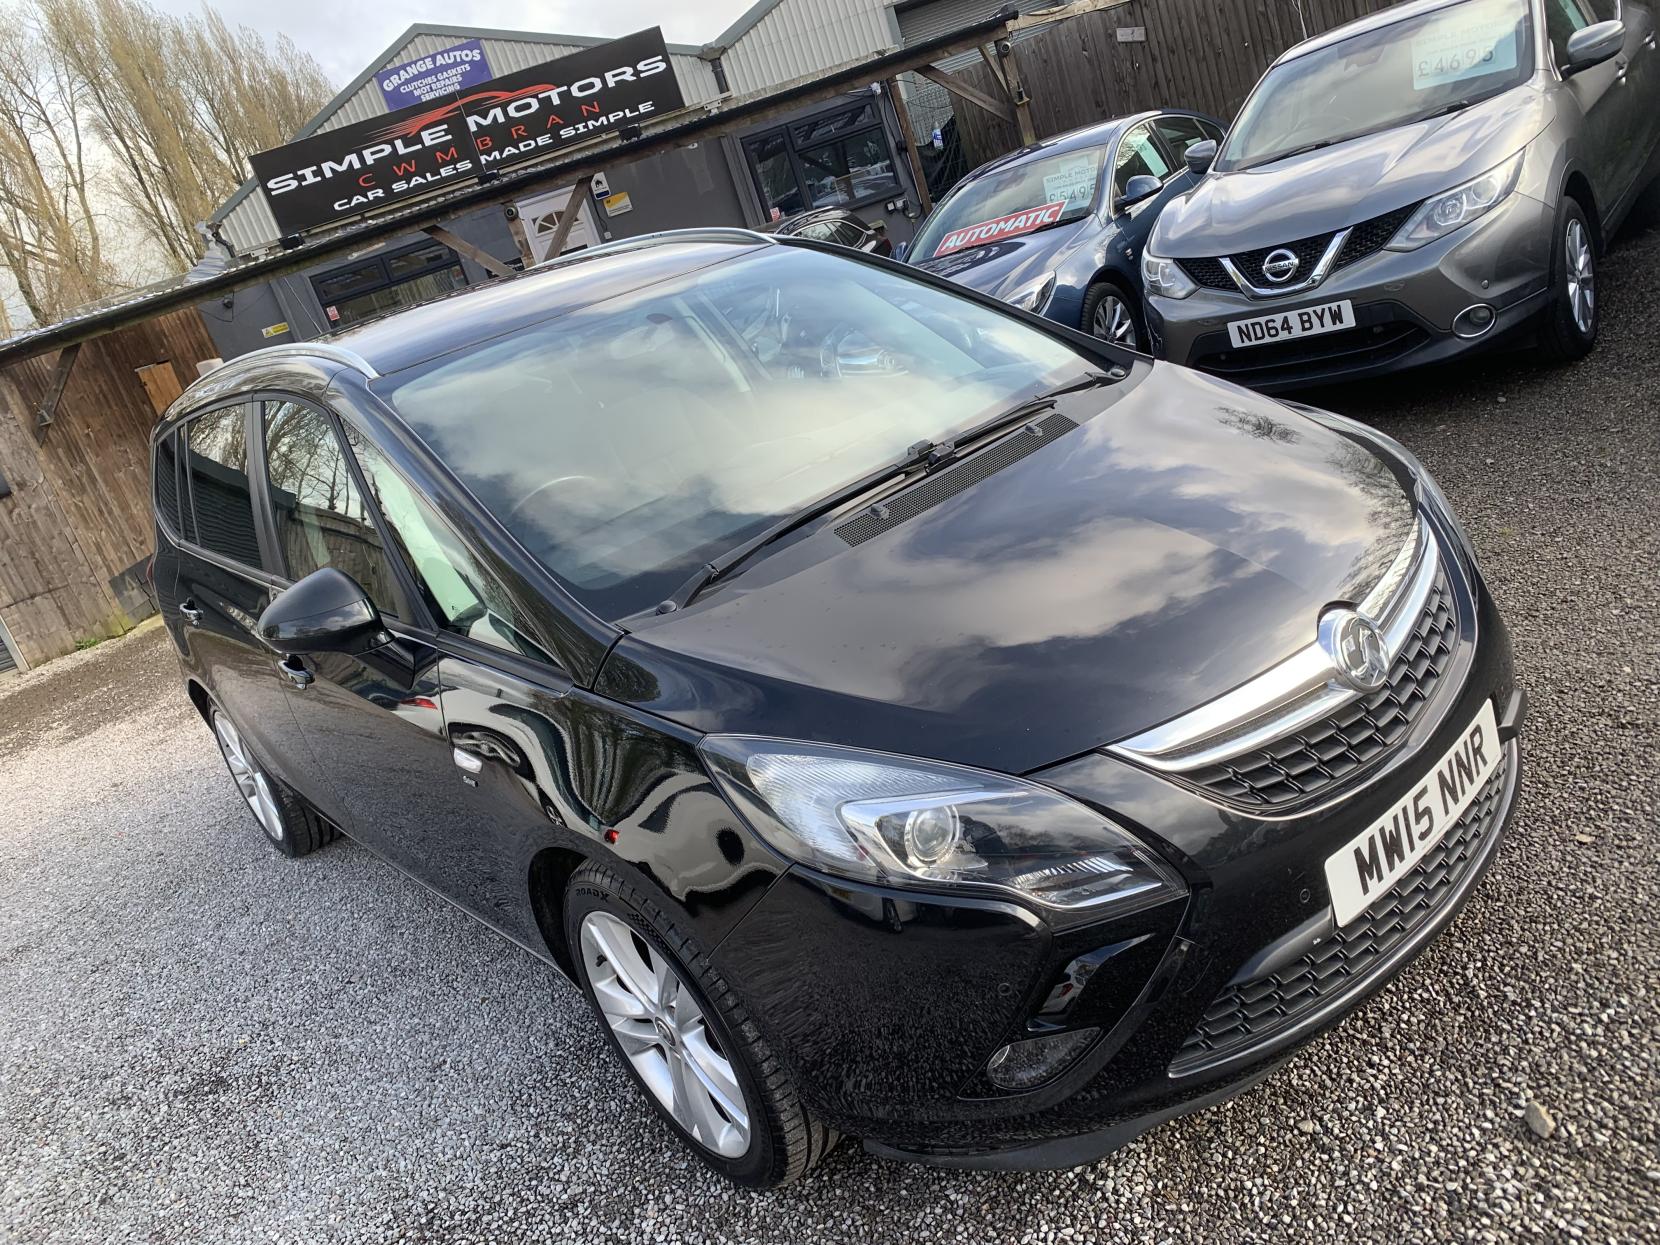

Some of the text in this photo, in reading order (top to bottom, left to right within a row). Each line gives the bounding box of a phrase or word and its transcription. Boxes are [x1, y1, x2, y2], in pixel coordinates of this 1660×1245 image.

[383, 49, 481, 91] GRANGE AUTOS
[400, 64, 471, 93] CLUTCHES GASKETS
[413, 75, 462, 97] MOT REPAIRS
[421, 83, 460, 102] SERVICING
[267, 55, 667, 196] SIMPLE MOTORS
[333, 101, 655, 211] CAR SALES MADE SIMPLE
[941, 206, 1060, 251] AUTOMATIC
[1265, 261, 1294, 272] NISSAN
[1237, 304, 1344, 343] ND64 BYW
[1353, 723, 1488, 896] MW15 NNR
